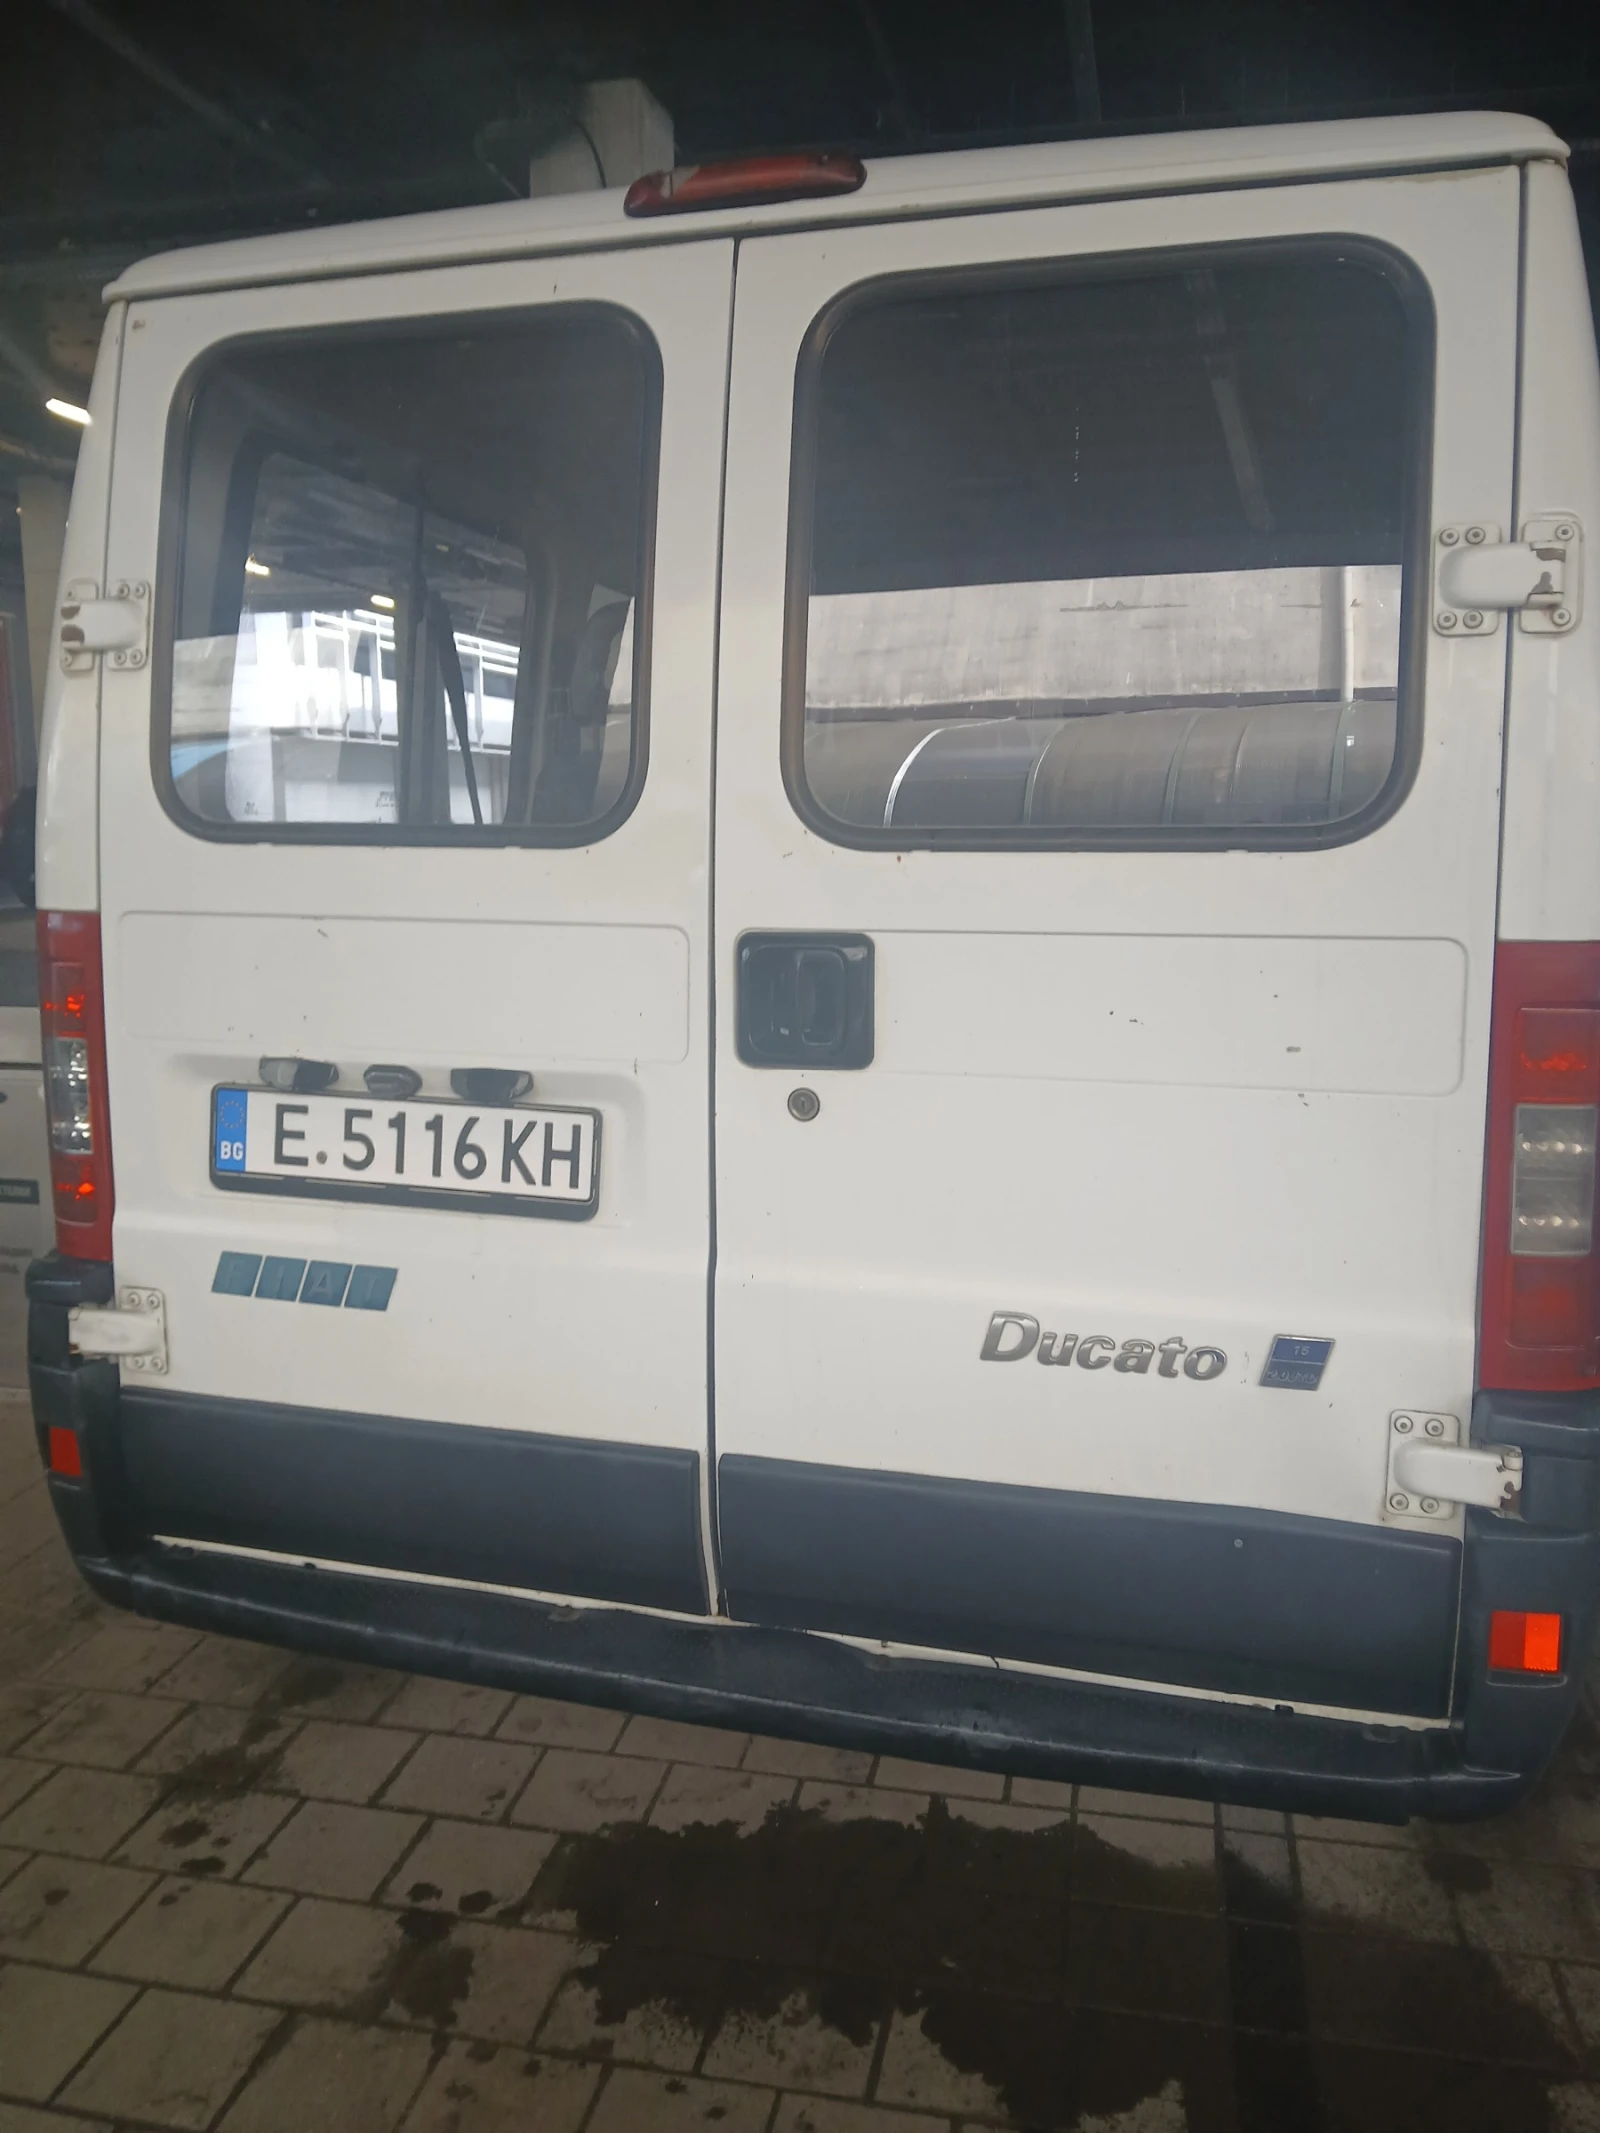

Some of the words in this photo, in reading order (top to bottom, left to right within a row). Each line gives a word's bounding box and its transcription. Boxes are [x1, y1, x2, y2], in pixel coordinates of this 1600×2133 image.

[220, 1140, 244, 1161] BG
[274, 1103, 582, 1190] E.5116KH
[221, 1257, 386, 1304] FIAT
[979, 1310, 1228, 1381] Ducato
